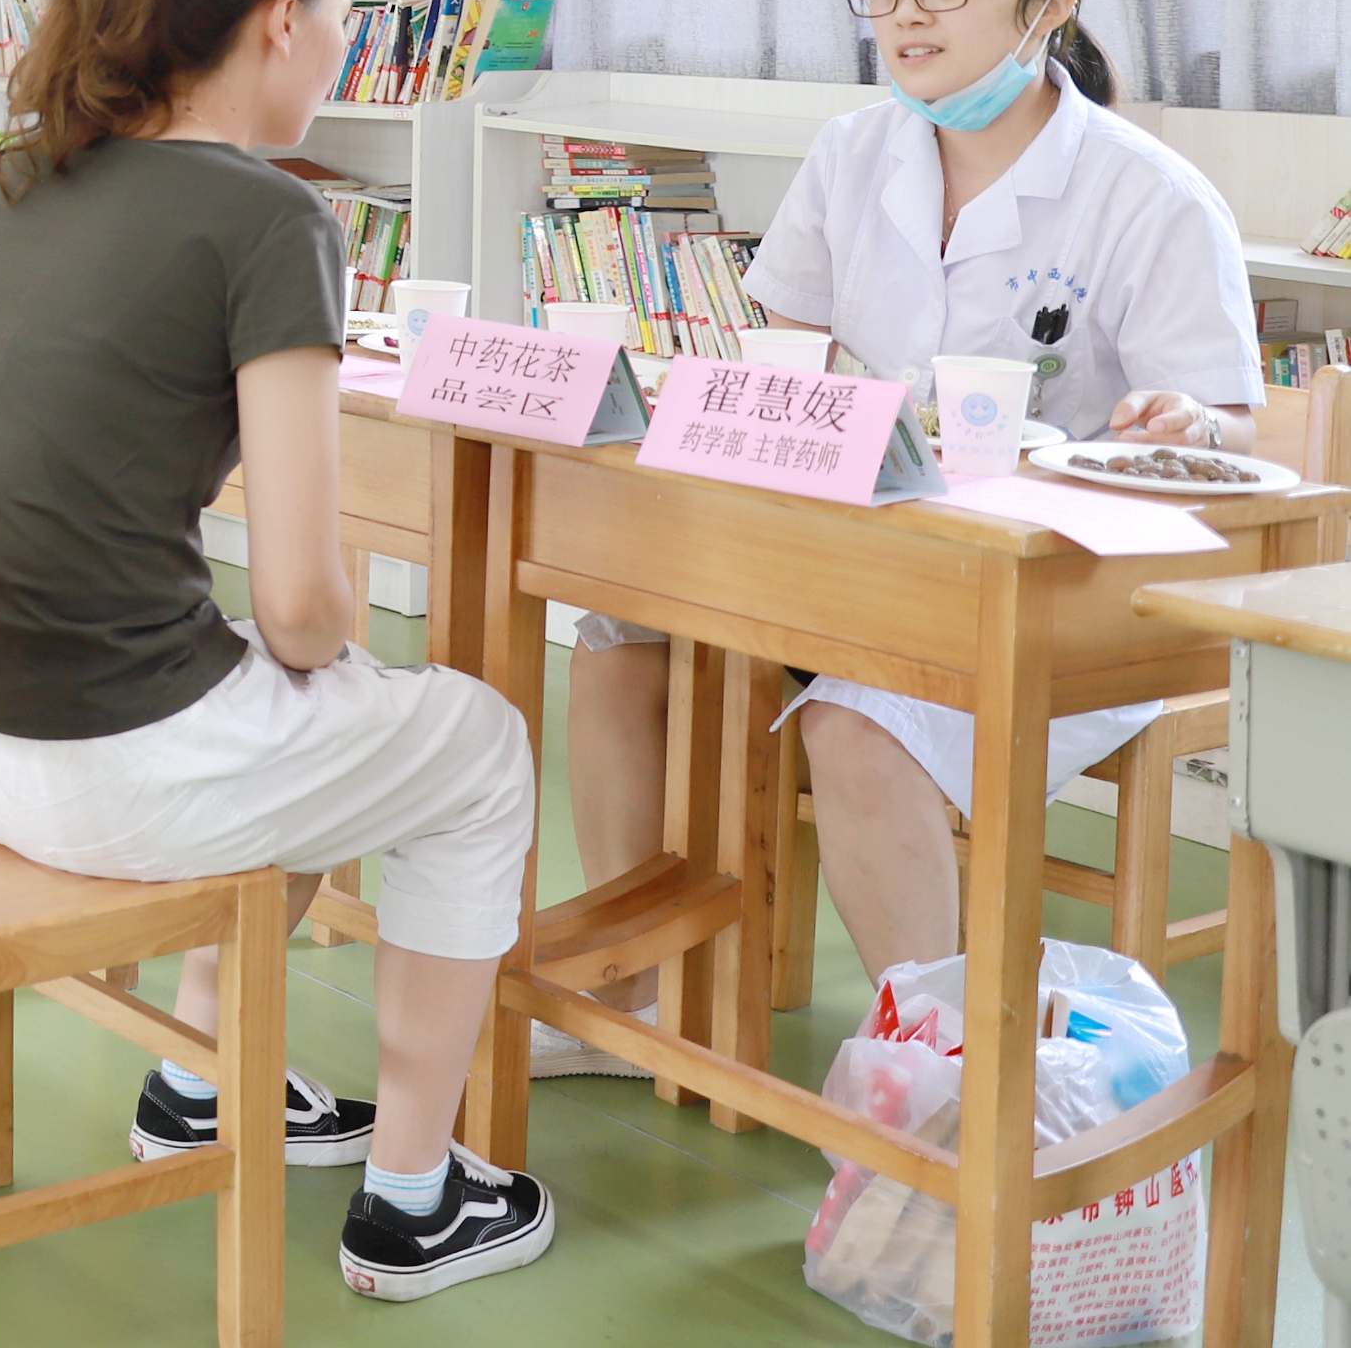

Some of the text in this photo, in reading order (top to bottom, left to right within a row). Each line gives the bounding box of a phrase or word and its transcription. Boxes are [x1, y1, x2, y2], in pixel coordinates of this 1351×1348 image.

[448, 332, 581, 384] 中药花茶
[431, 377, 564, 422] 品尝区
[697, 367, 858, 434] 翟慧媛
[678, 421, 843, 476] 药学部 主管药师
